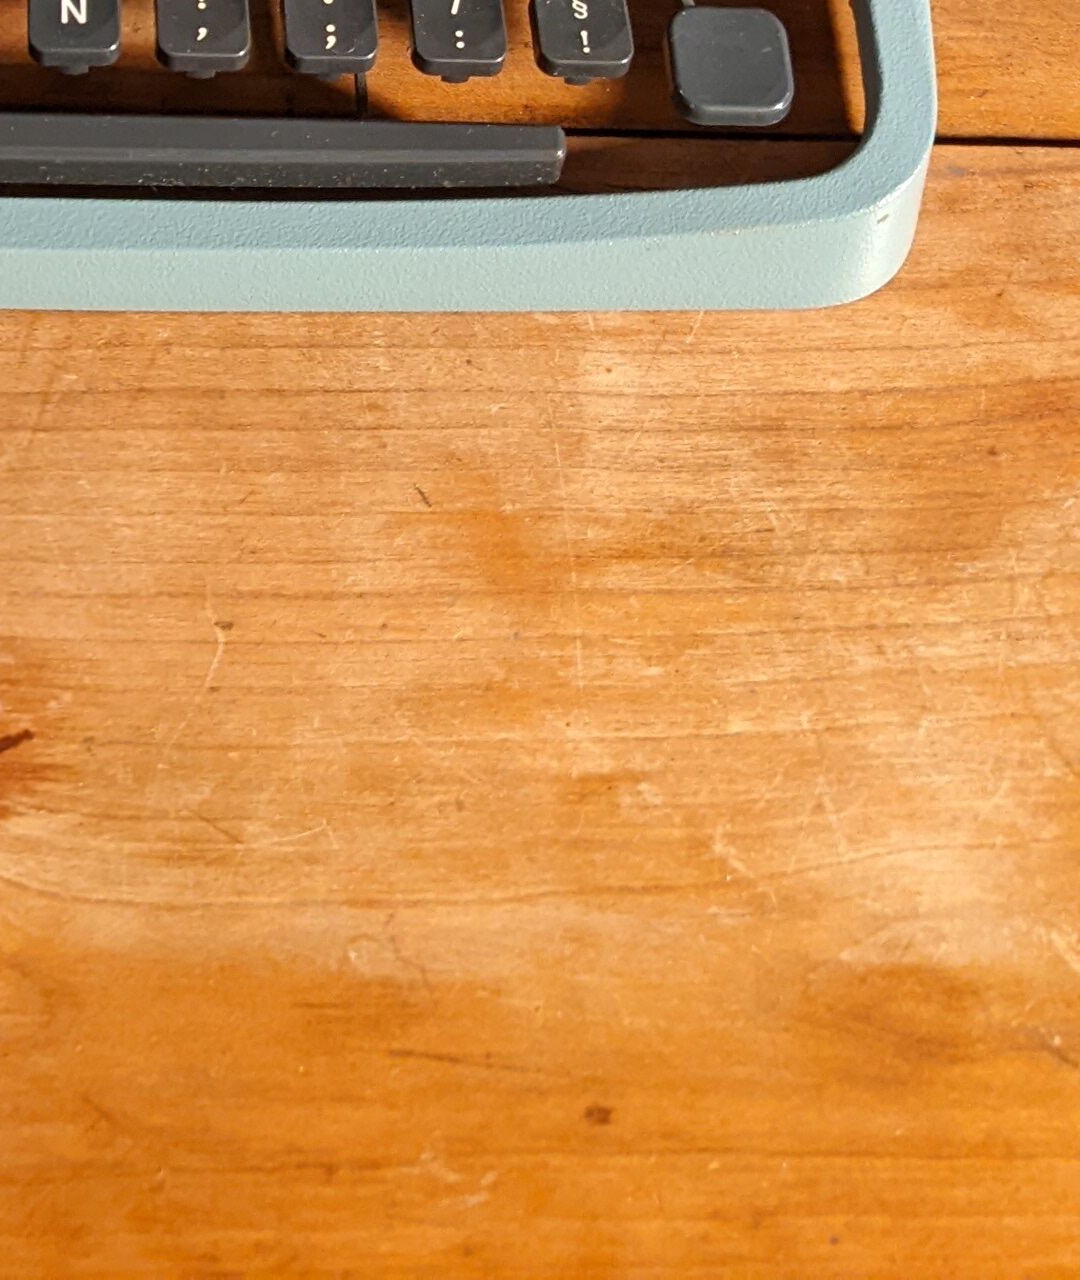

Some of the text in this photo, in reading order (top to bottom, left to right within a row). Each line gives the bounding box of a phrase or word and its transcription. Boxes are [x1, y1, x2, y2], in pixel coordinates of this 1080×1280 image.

[325, 24, 338, 51] ;
[455, 30, 465, 49] :
[580, 30, 591, 54] !
